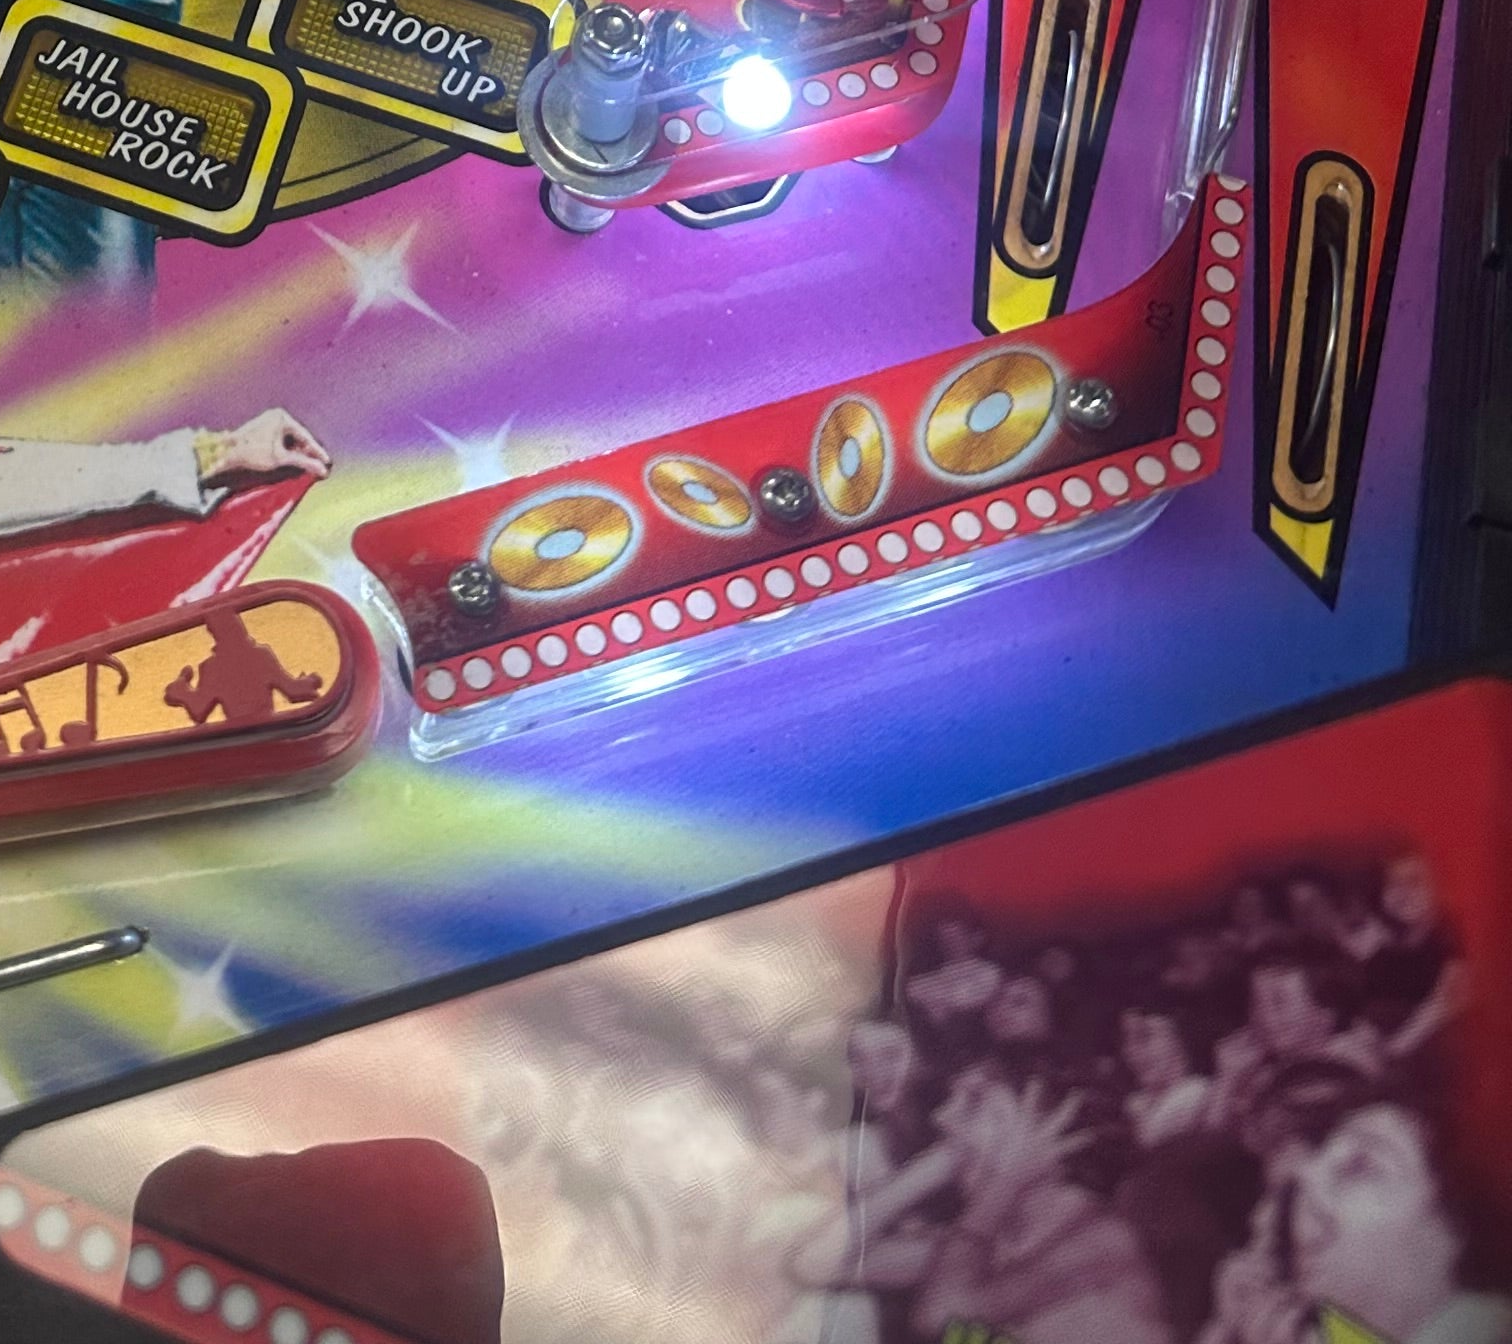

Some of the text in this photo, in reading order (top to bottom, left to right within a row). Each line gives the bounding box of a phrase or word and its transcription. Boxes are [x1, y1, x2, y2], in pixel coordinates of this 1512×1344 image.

[38, 39, 122, 88] JAIL
[337, 2, 485, 66] SHOOK
[63, 80, 201, 145] HOUSE
[439, 70, 498, 105] UP
[108, 132, 230, 192] ROCK
